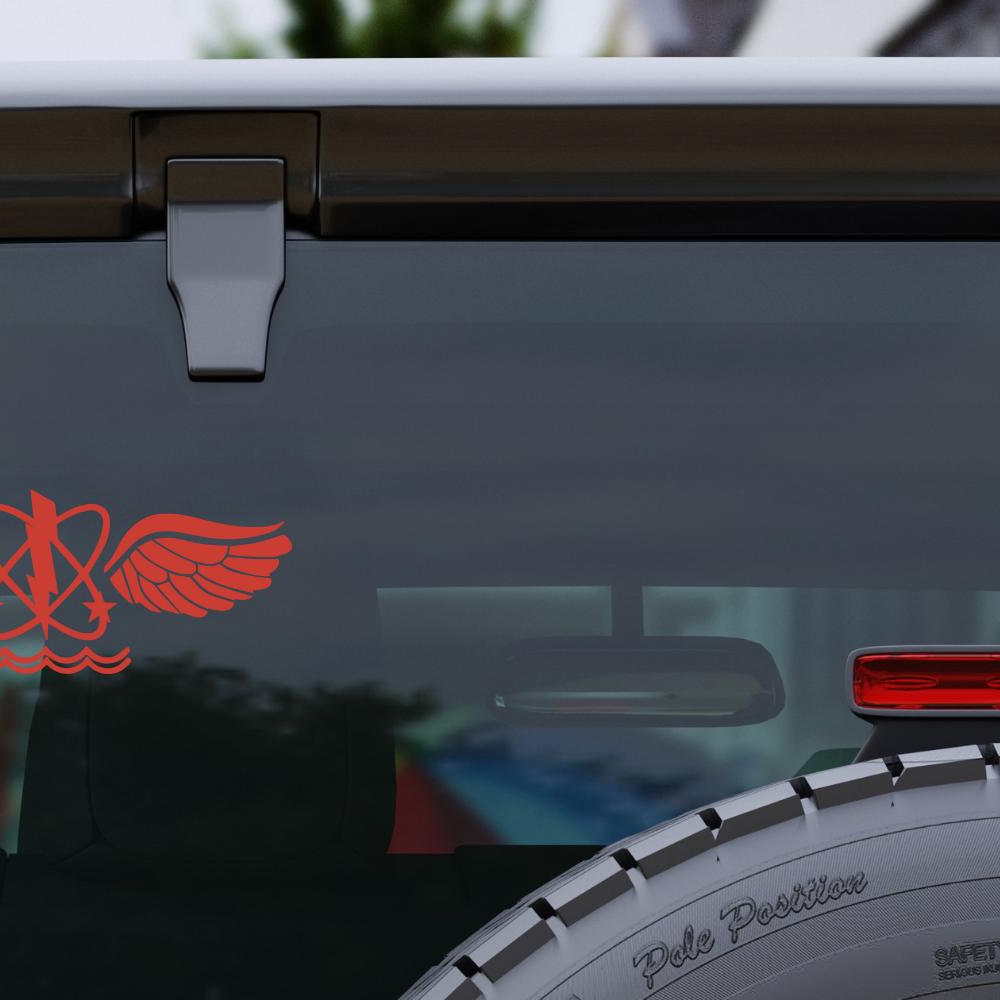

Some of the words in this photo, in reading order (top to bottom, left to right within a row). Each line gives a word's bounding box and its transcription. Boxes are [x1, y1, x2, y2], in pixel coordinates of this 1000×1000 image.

[633, 923, 715, 990] Pole
[720, 871, 869, 944] Position
[935, 941, 1000, 967] SAFET
